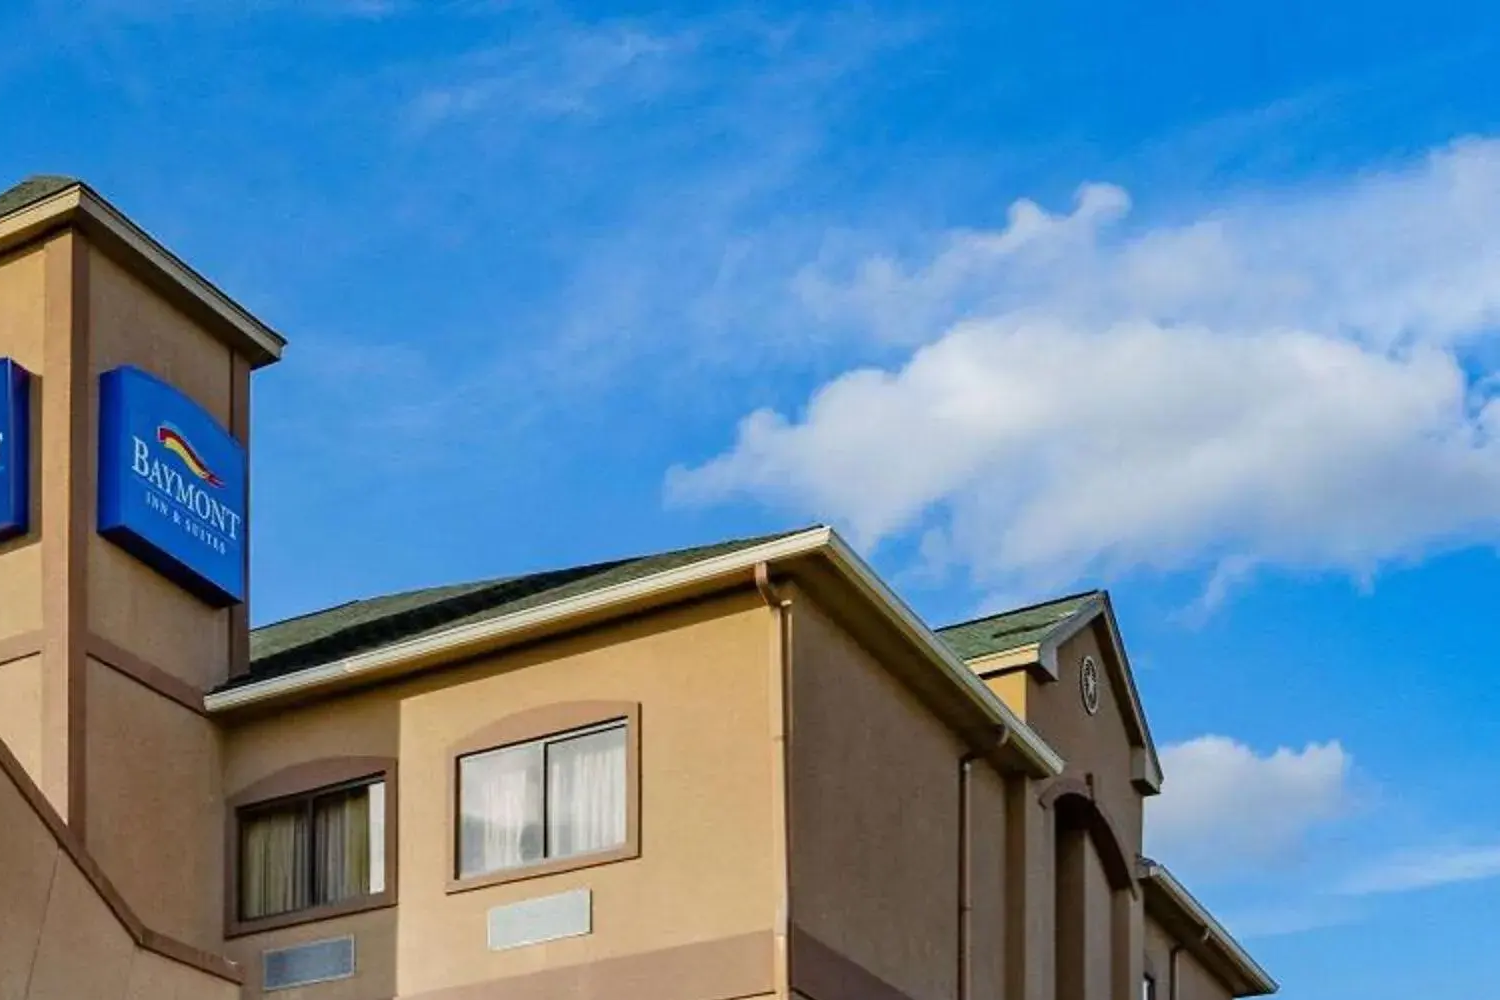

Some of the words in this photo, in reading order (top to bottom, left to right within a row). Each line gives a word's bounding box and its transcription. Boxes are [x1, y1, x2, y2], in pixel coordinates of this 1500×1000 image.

[131, 435, 242, 541] BAYMONT
[146, 491, 169, 517] INN
[184, 519, 227, 555] SUITES
